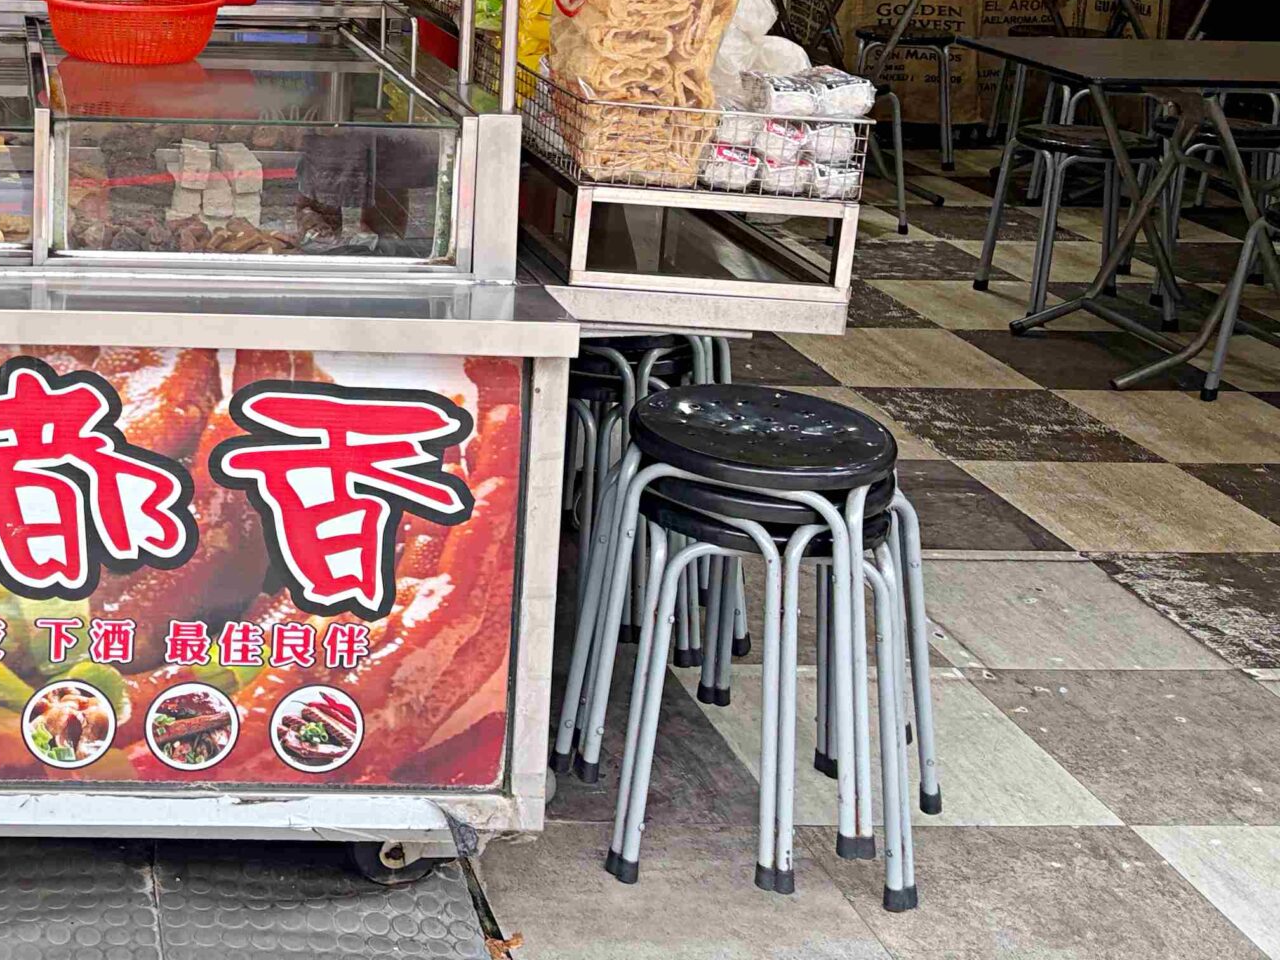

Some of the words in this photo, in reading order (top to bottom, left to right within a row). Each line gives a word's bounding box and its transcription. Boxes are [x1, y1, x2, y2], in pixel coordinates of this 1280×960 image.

[905, 50, 962, 62] MAROS
[36, 617, 135, 665] 下酒
[166, 620, 371, 669] 最佳良伴
